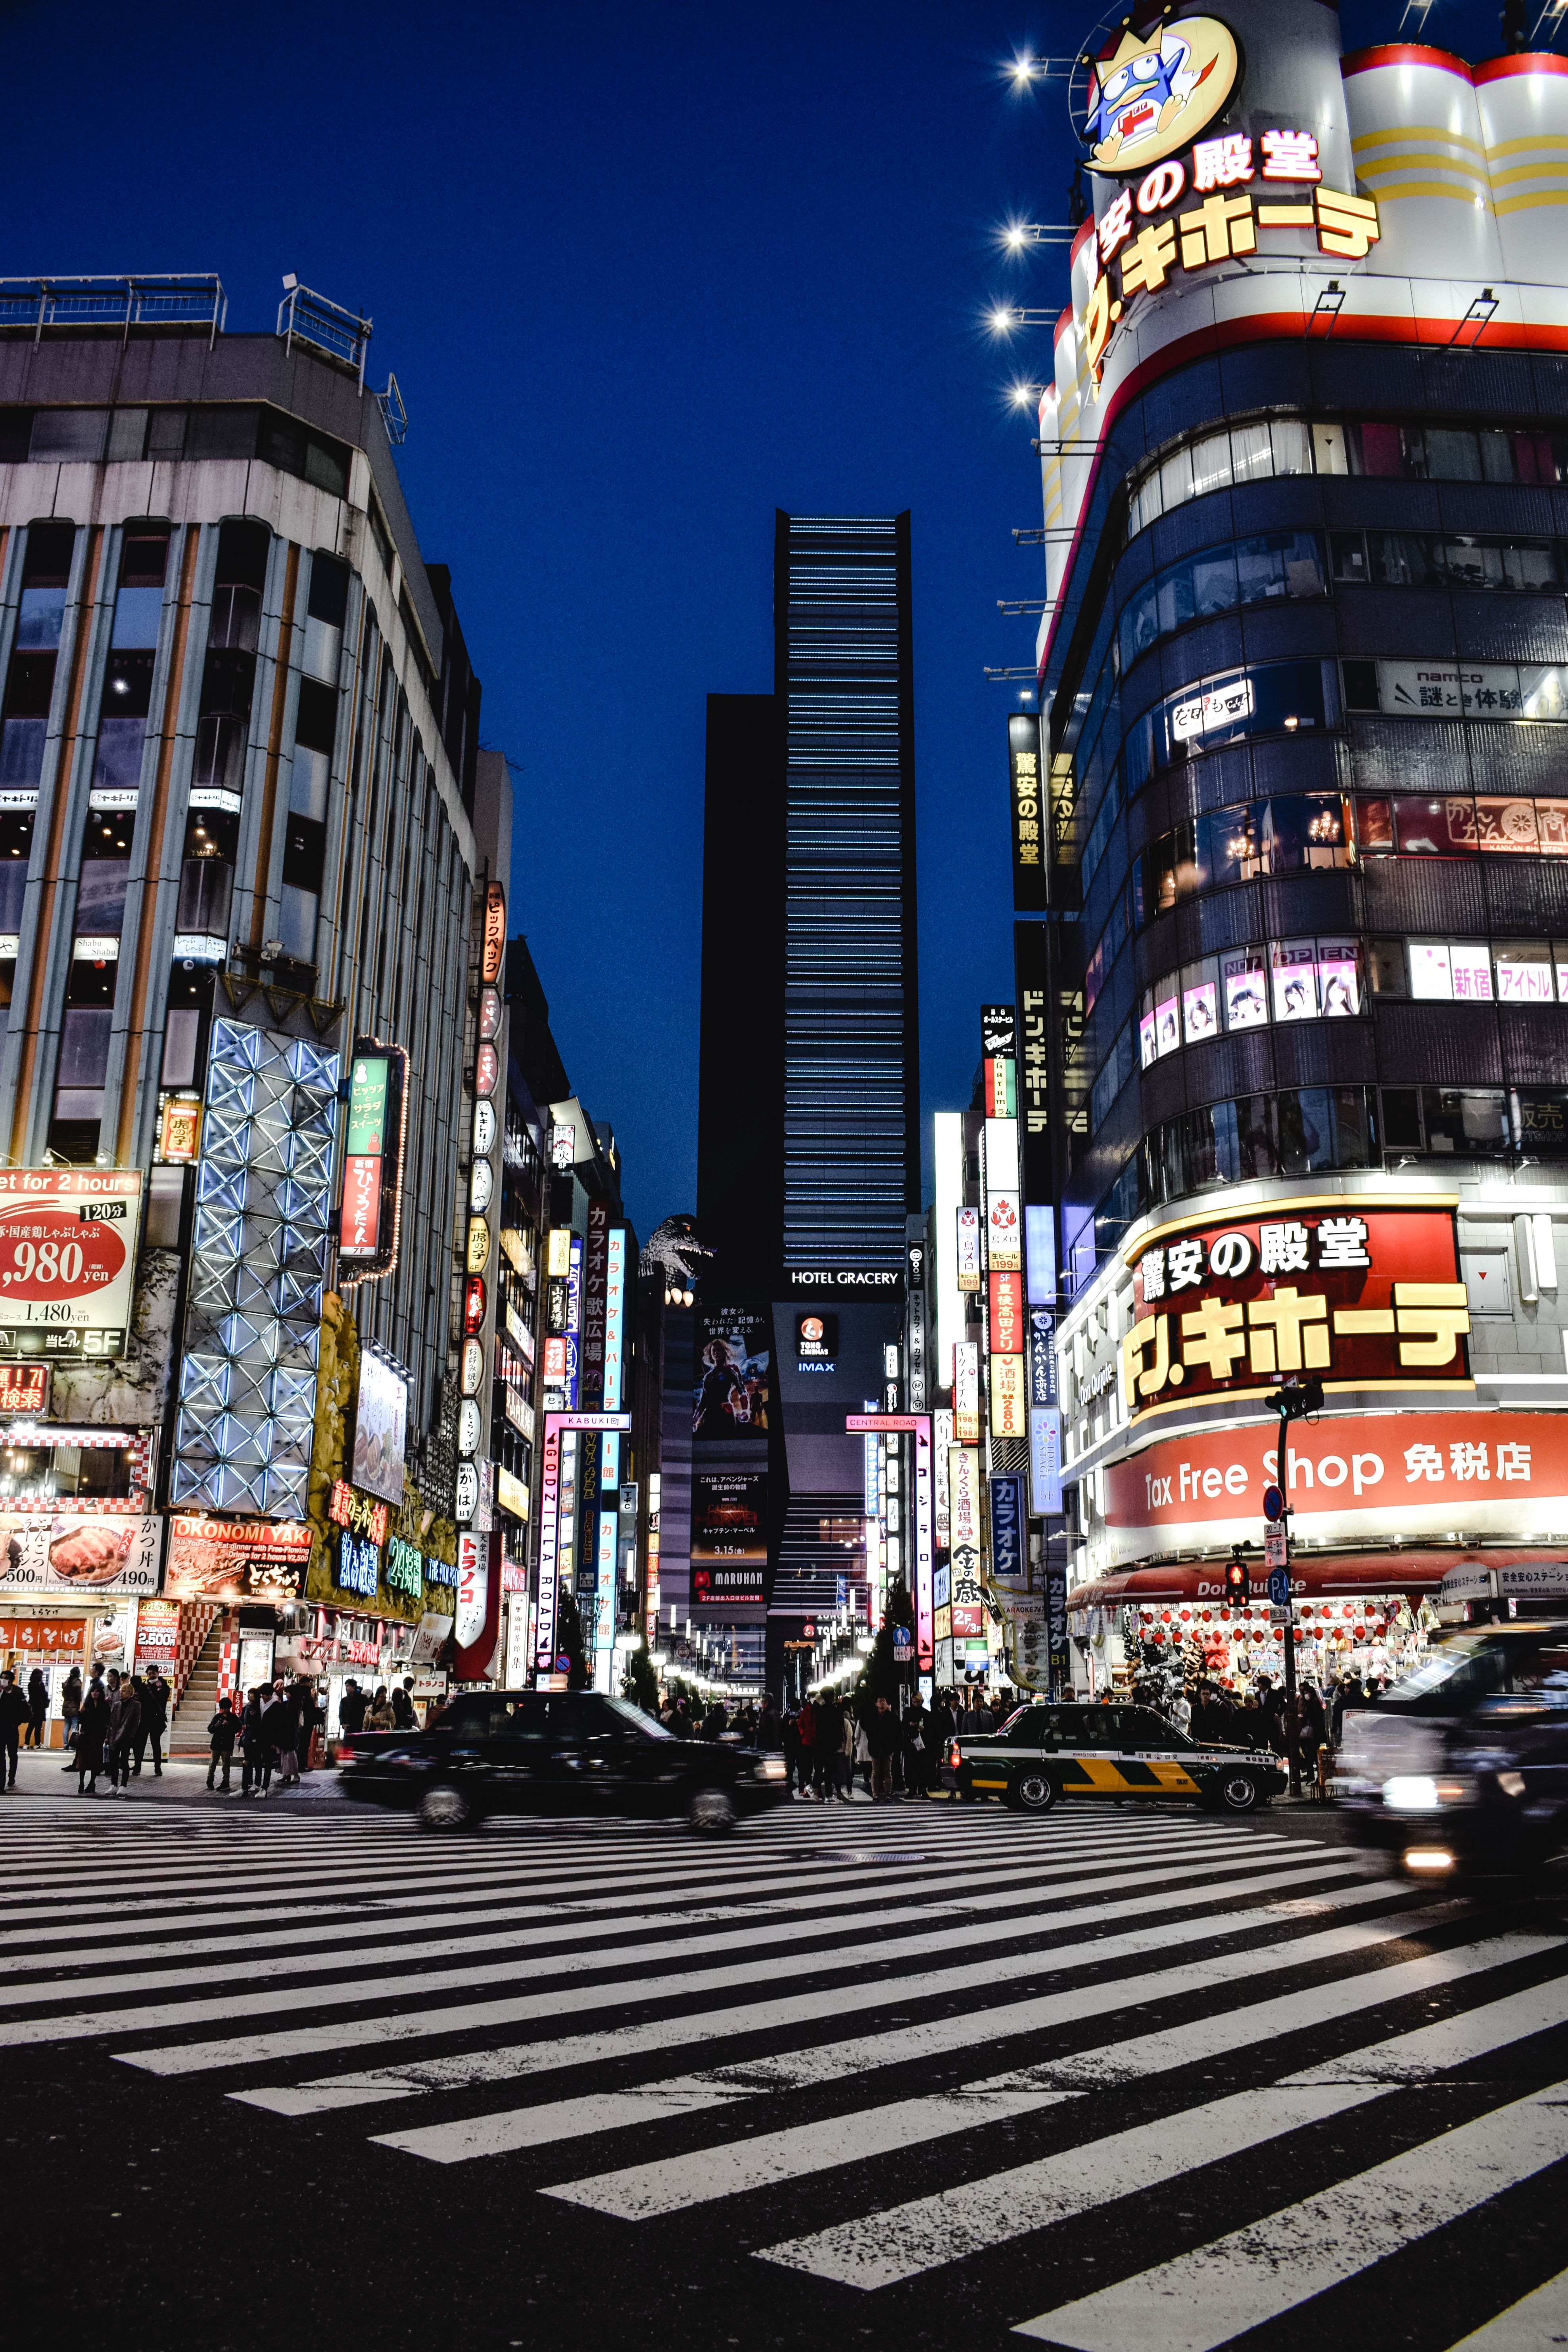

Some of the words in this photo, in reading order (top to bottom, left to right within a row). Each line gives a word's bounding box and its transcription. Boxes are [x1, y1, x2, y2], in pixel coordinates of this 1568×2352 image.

[1417, 672, 1483, 683] namco
[1016, 753, 1039, 864] 驚安の殿堂
[353, 1084, 384, 1096] ピッツァ
[996, 1062, 1006, 1105] Garam
[353, 1101, 381, 1112] サラダ
[173, 1118, 189, 1145] 虎の子
[351, 1118, 382, 1130] スイーツ
[355, 1159, 374, 1168] 新宿
[23, 1173, 52, 1190] for
[58, 1174, 71, 1190] 2
[77, 1174, 134, 1191] hours
[83, 1205, 123, 1221] 120分
[353, 1168, 374, 1244] ひょうたん
[471, 1232, 486, 1260] 虎の子
[992, 1235, 1017, 1243] 鳥メロ
[558, 1236, 566, 1270] 鳥貴族
[964, 1240, 974, 1270] 鳥メロ
[1141, 1216, 1371, 1303] 驚安の殿堂
[83, 1270, 109, 1283] yen
[585, 1207, 607, 1362] カラオケ歌広場
[792, 1272, 835, 1284] HOTEL
[837, 1272, 898, 1285] GRACERY
[1000, 1273, 1010, 1282] 5F
[25, 1303, 71, 1323] 1,480
[71, 1312, 90, 1323] yen
[479, 1310, 484, 1323] 3F
[551, 1285, 564, 1323] 山内農場
[997, 1283, 1014, 1351] 豊後高田どり
[83, 1331, 121, 1353] 5F
[467, 1348, 477, 1389] お好み焼き
[798, 1363, 835, 1372] IMAX
[1034, 1331, 1048, 1401] かんかん商店
[1000, 1367, 1017, 1392] 酒場
[1080, 1383, 1091, 1406] Don
[1091, 1363, 1112, 1395] Quijote
[1, 1388, 41, 1409] 検索
[1003, 1400, 1014, 1430] 280
[957, 1452, 972, 1524] きんくら酒場
[1146, 1473, 1173, 1510] Tax
[1180, 1462, 1249, 1502] Free
[1262, 1447, 1386, 1496] Shop
[1403, 1442, 1532, 1484] 免税店
[543, 1449, 557, 1562] GODZILLA
[707, 1503, 748, 1512] CAPTAIN
[1040, 1490, 1055, 1500] 5F
[584, 1510, 594, 1531] Shop
[695, 1512, 764, 1527] MARVEL
[996, 1481, 1017, 1571] カラオケ
[19, 1519, 32, 1566] ラーメン
[33, 1518, 47, 1567] とんこつ
[120, 1530, 132, 1554] 大人気
[137, 1519, 157, 1568] かつ丼
[177, 1520, 266, 1542] OKONOMI
[270, 1528, 312, 1545] YAKI
[584, 1531, 593, 1550] Free
[918, 1467, 929, 1620] ゴジラロード
[268, 1545, 309, 1554] Free-Flowing
[478, 1534, 487, 1572] 大衆酒場
[583, 1550, 593, 1564] Tax
[340, 1531, 378, 1596] 飲み放題
[389, 1537, 422, 1598] 24時間
[460, 1538, 477, 1603] トラノコ
[953, 1543, 980, 1603] 金の蔵
[6, 1569, 42, 1584] 500円
[119, 1570, 155, 1586] 490円
[598, 1524, 612, 1635] カラオケ館
[715, 1573, 762, 1585] MARUHAN
[1272, 1577, 1279, 1600] P
[540, 1576, 553, 1631] ROAD
[1049, 1578, 1067, 1650] カラオケ
[0, 1627, 83, 1645] とらそば
[138, 1633, 175, 1646] 2,500円
[1051, 1654, 1066, 1665] B1
